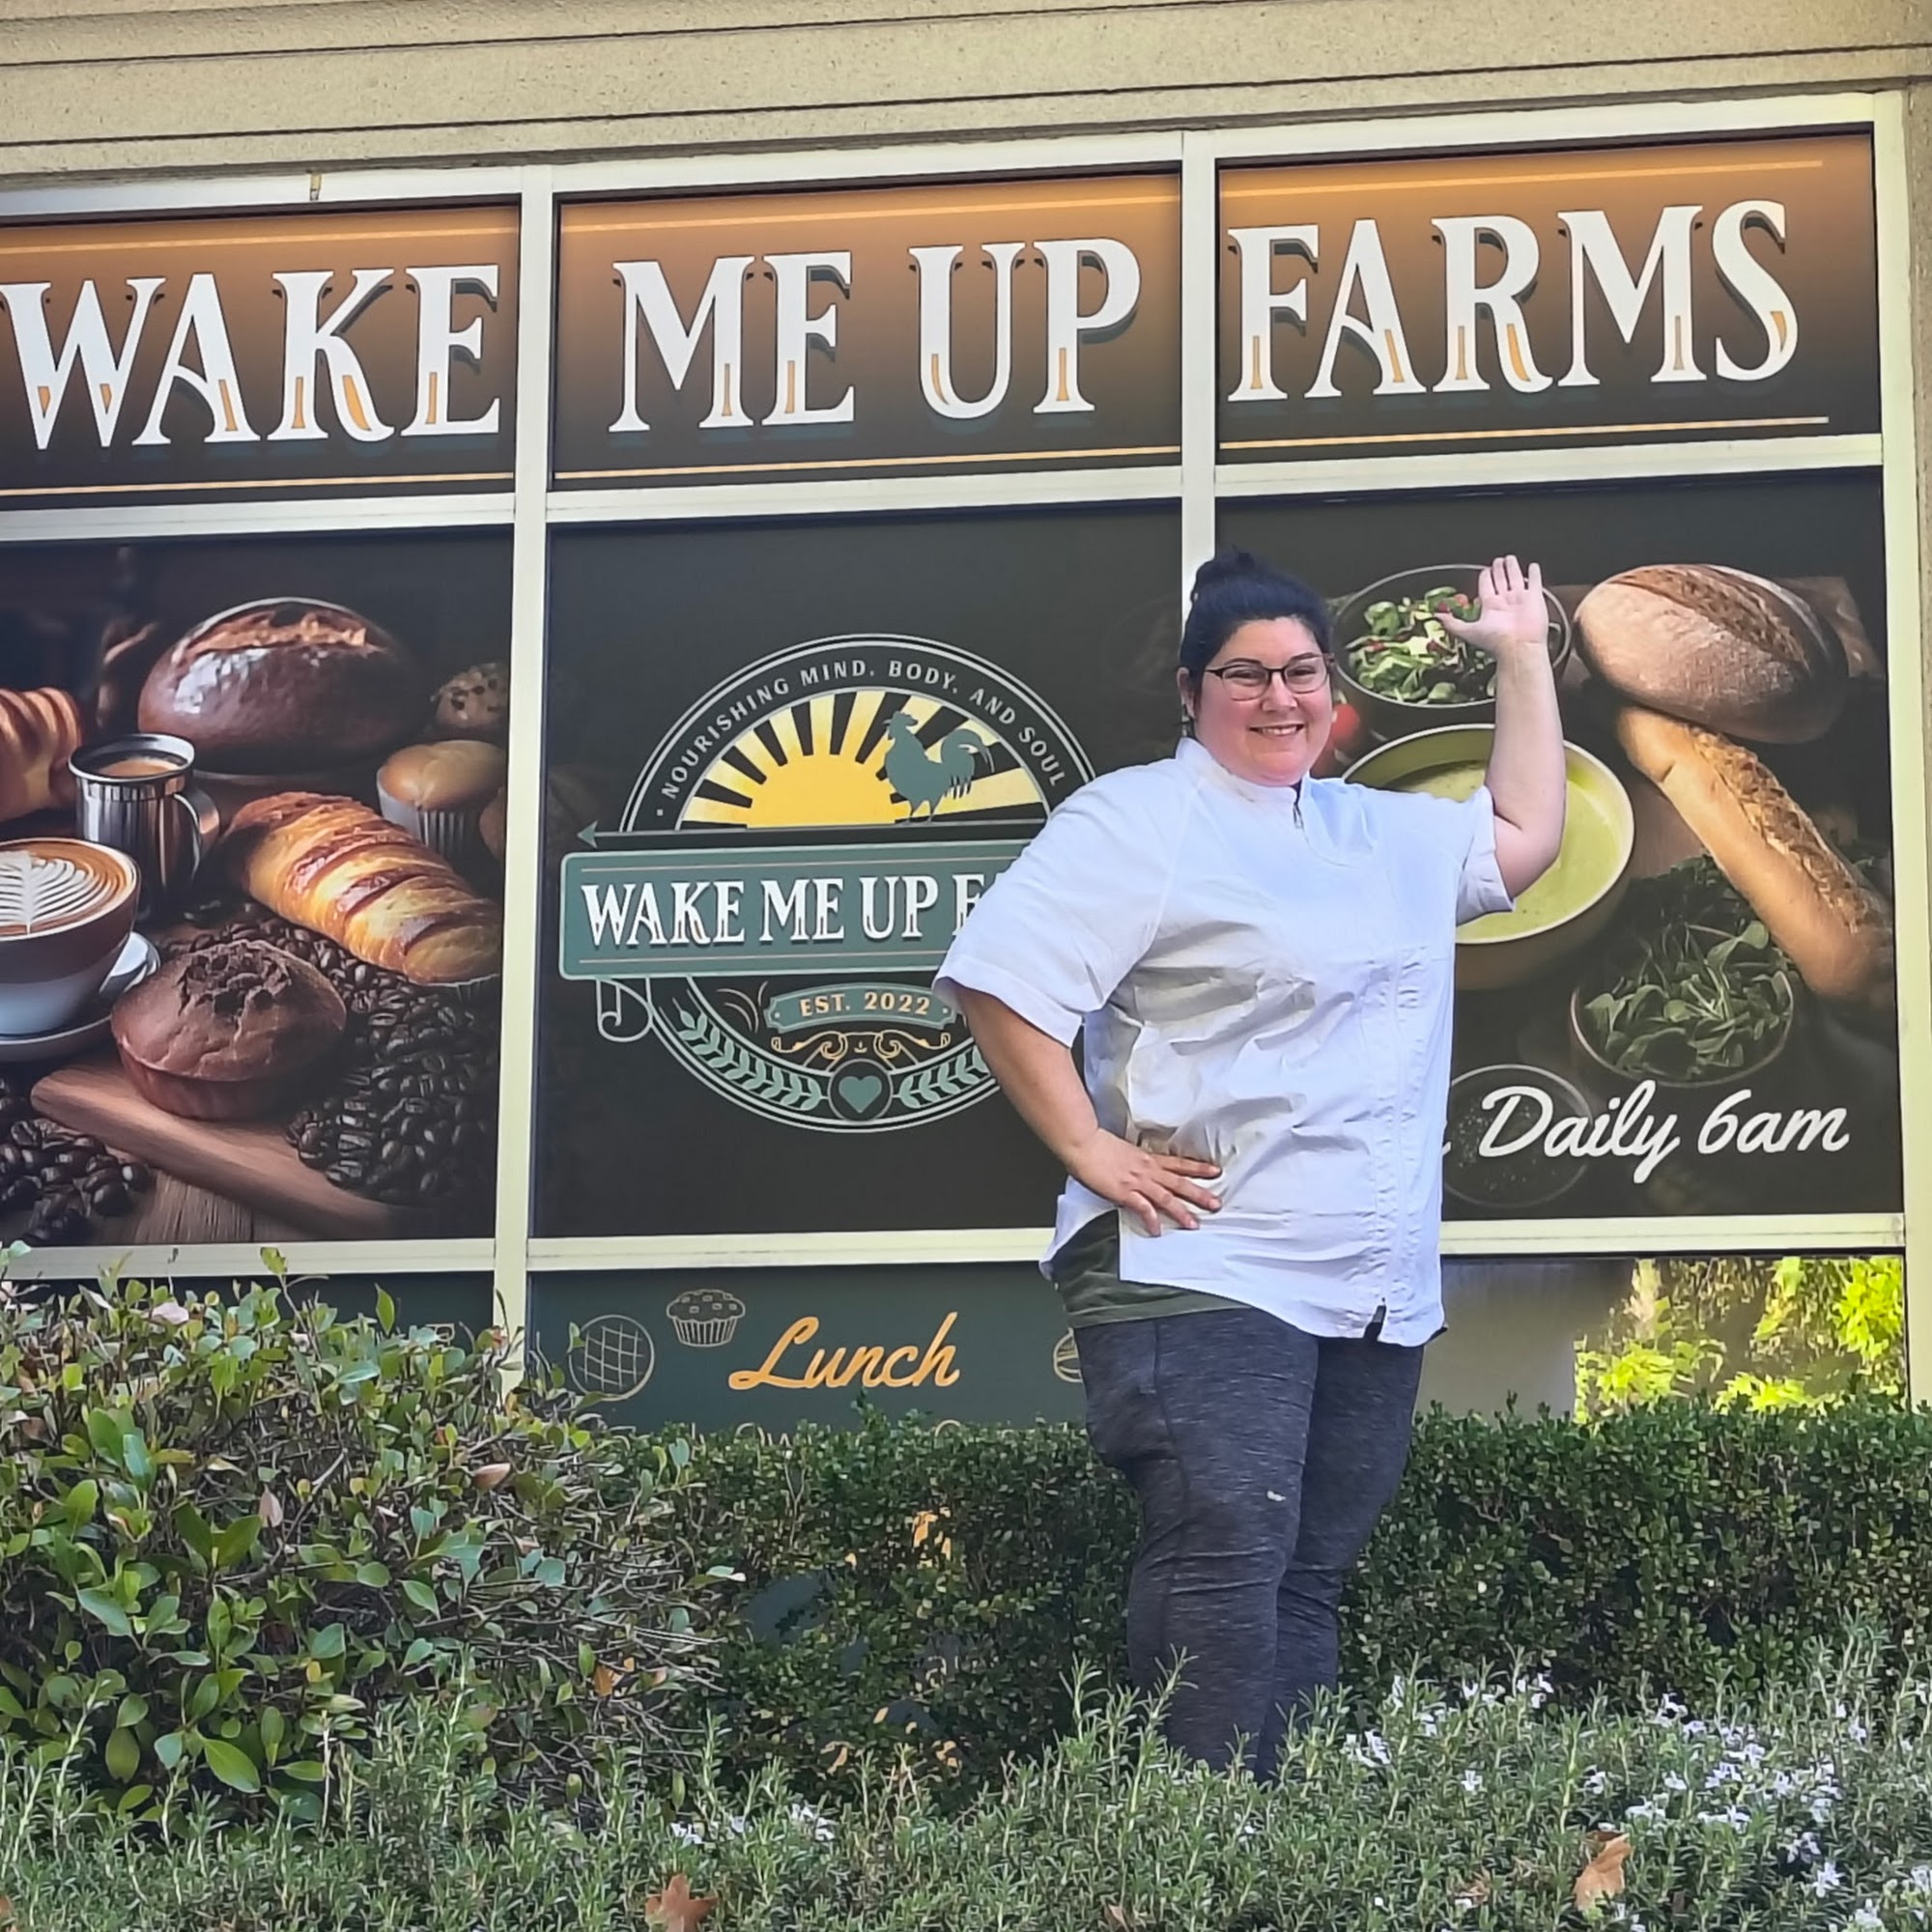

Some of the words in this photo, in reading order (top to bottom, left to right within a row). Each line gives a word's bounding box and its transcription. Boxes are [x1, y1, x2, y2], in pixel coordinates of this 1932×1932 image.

[0, 264, 500, 450] WAKE
[609, 251, 855, 433] ME
[908, 238, 1142, 419] UP
[1227, 199, 1800, 402] FARMS
[661, 677, 790, 799] NOURISHING
[969, 688, 1016, 724] AND
[1018, 726, 1065, 787] SOUL
[582, 880, 745, 946] WAKE
[759, 877, 845, 942] ME
[860, 874, 939, 939] UP
[799, 992, 851, 1017] EST.
[864, 991, 930, 1015] 2022
[1478, 1079, 1682, 1184] Daily
[1697, 1089, 1851, 1154] 6am
[728, 1311, 961, 1391] Lunch
